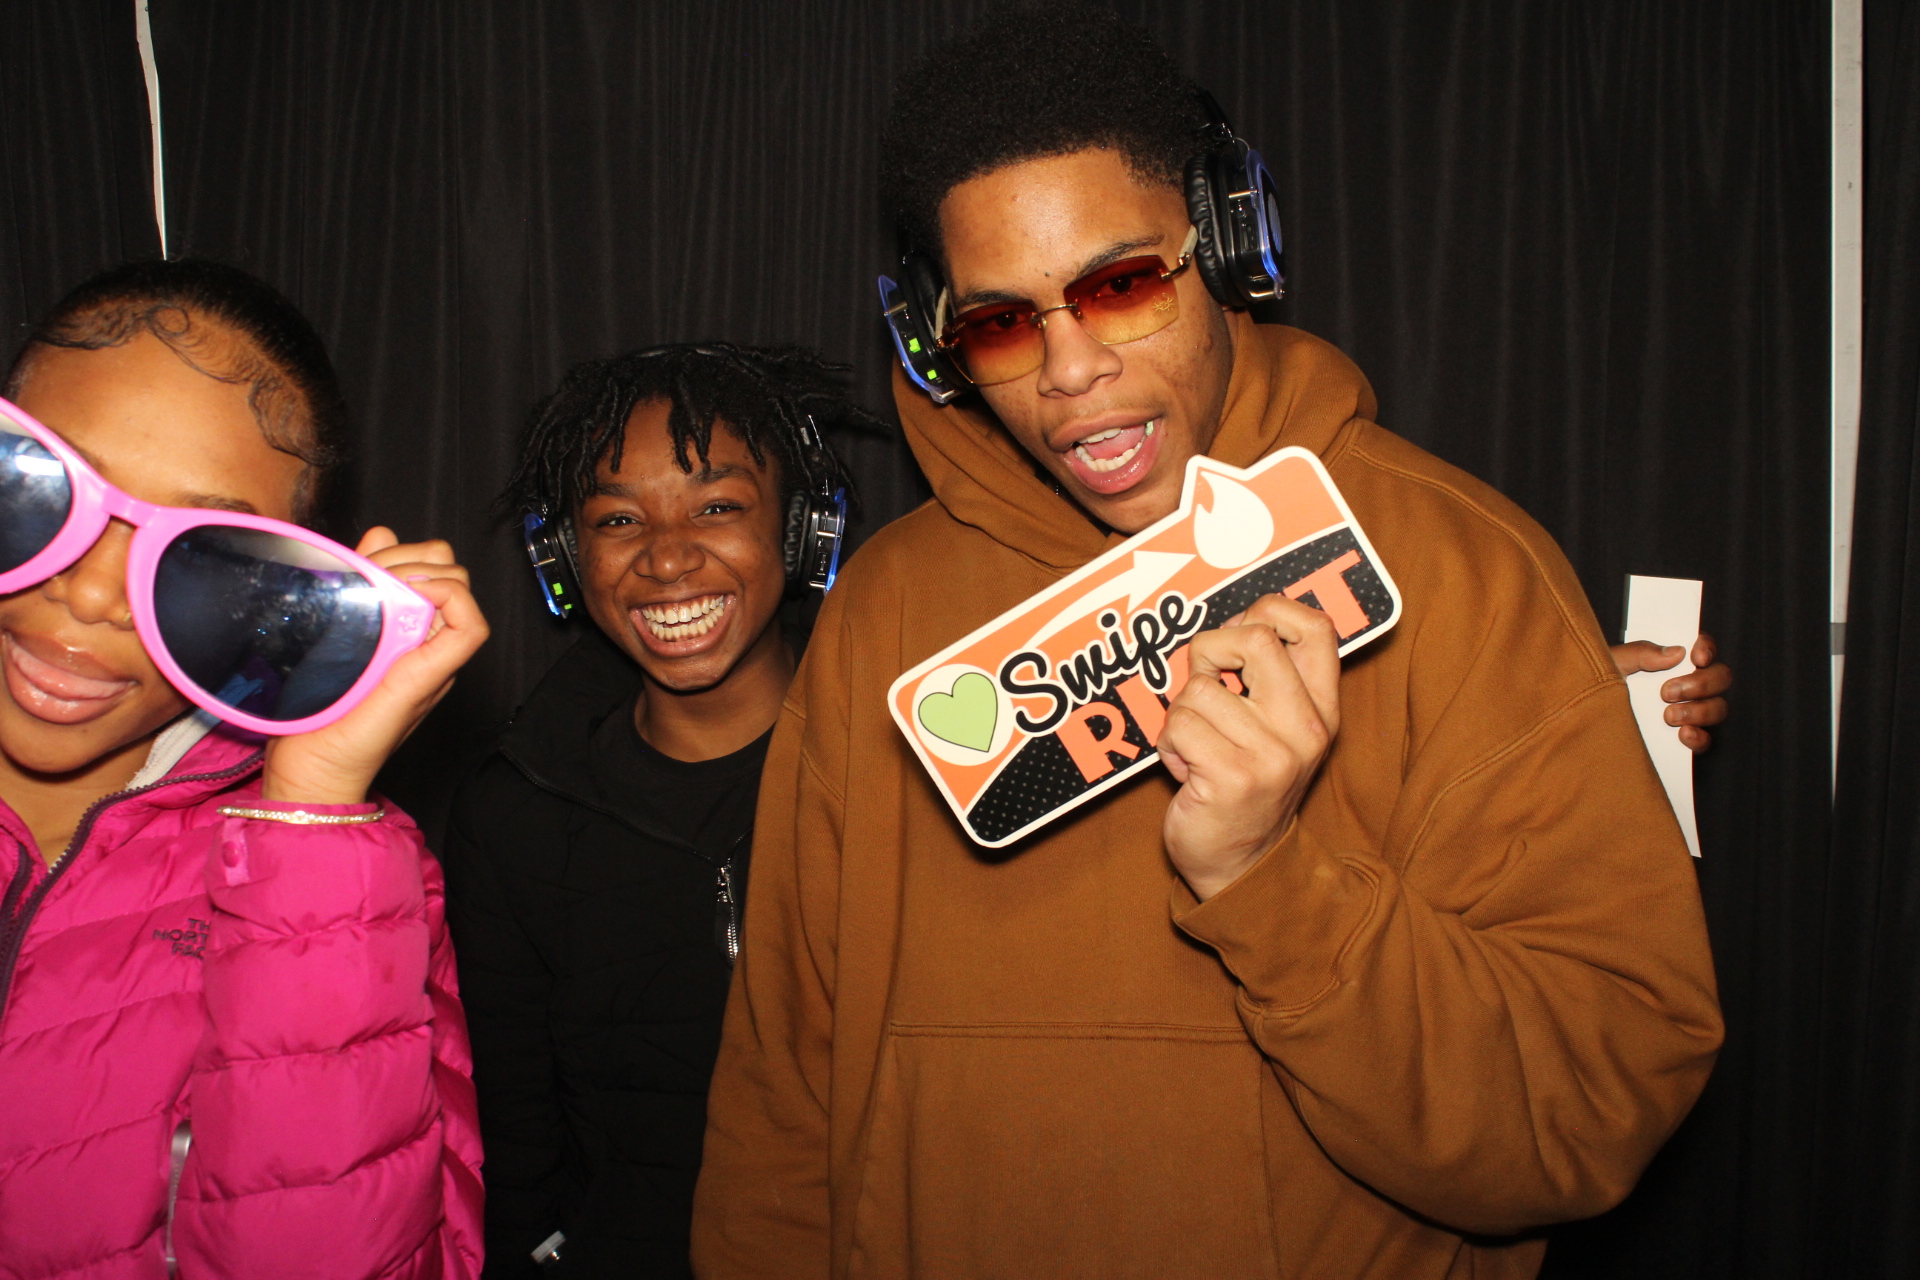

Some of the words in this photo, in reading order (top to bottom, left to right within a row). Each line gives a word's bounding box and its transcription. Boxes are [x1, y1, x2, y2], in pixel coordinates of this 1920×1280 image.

[1000, 594, 1204, 733] Swipe
[1055, 549, 1370, 784] RIT
[188, 918, 211, 932] TH
[153, 929, 208, 944] NORT
[172, 942, 205, 960] FAC
